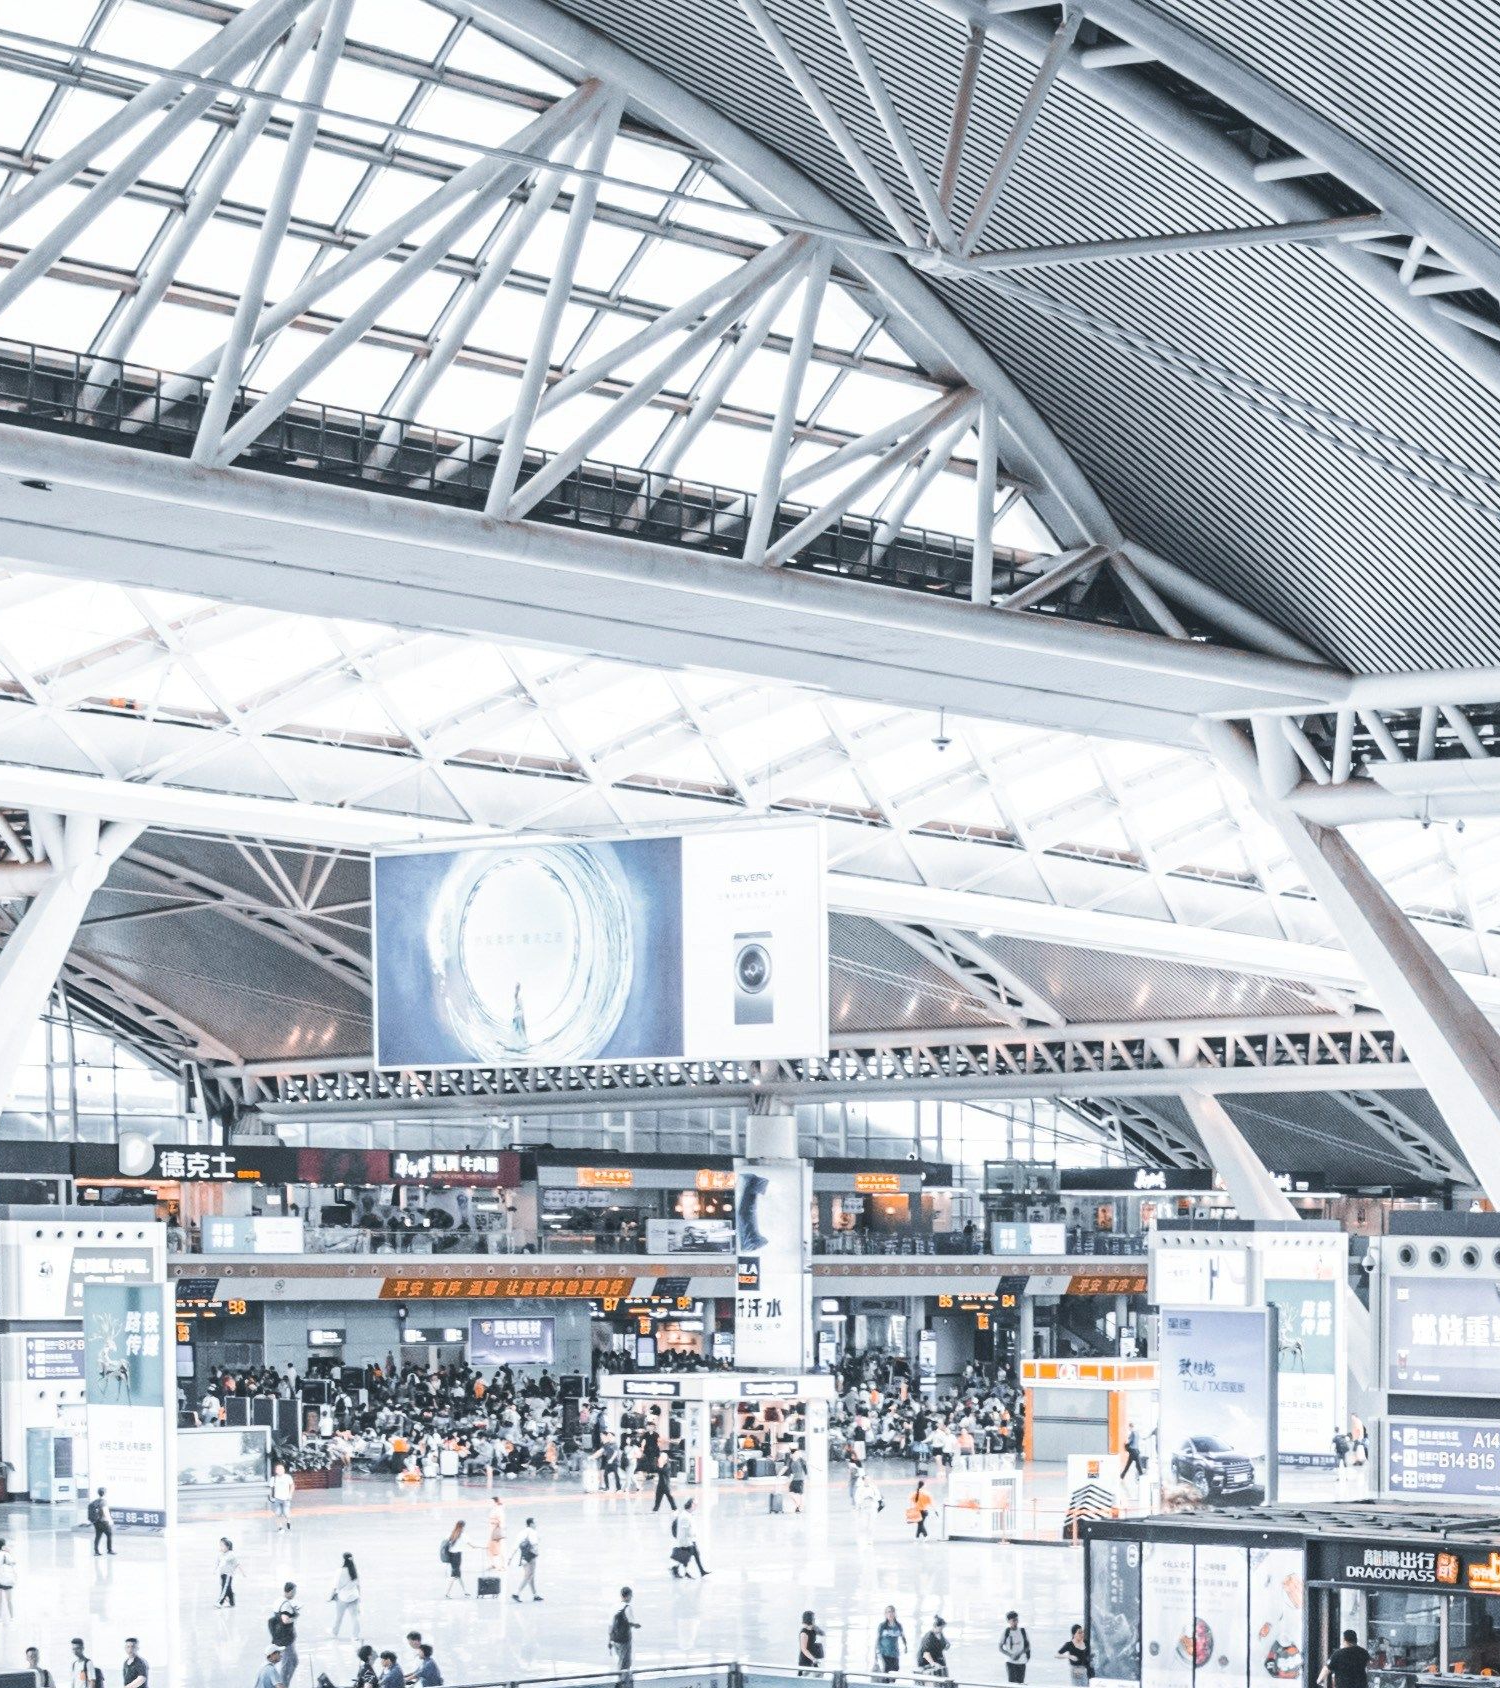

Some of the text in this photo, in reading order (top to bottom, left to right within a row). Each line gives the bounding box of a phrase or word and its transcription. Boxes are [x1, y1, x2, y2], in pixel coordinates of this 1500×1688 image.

[159, 1151, 236, 1178] 德克士
[395, 1281, 425, 1296] 平安
[432, 1281, 462, 1296] 有序
[1346, 1565, 1435, 1582] DRAGONPASS
